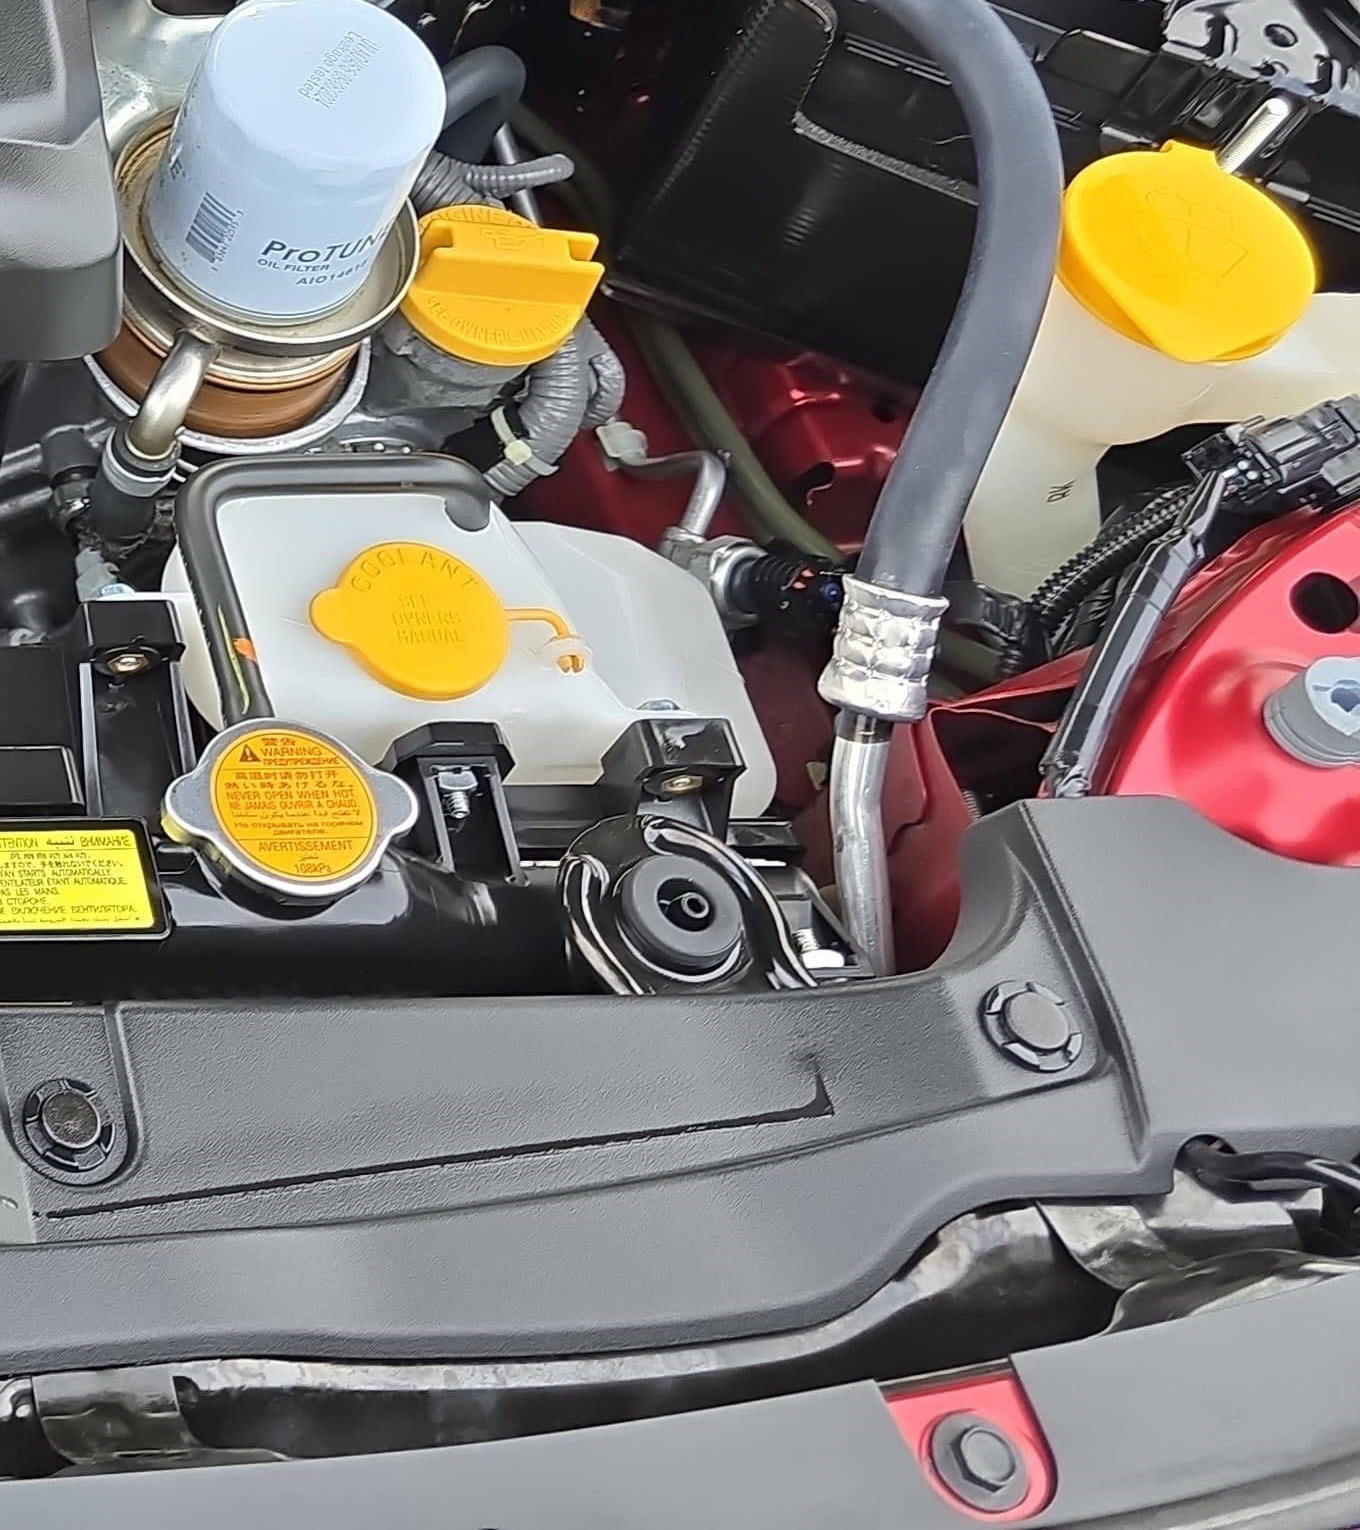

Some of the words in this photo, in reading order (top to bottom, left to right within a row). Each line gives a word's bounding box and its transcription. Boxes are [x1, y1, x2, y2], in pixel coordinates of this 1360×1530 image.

[256, 257, 281, 270] OIL
[283, 263, 331, 273] FILTER
[350, 548, 480, 593] COOLANT
[397, 627, 464, 645] MANUAL
[261, 746, 322, 757] WARNING
[226, 791, 260, 800] NEVER
[264, 790, 293, 799] OPEN
[296, 789, 329, 799] WHEN
[228, 801, 241, 810] NE
[244, 800, 277, 810] JAMAIS
[279, 799, 314, 810] OUVRIR
[79, 835, 132, 848] ВНИМАНИЕ
[258, 840, 353, 852] AVERTISSEMENT
[0, 870, 15, 878] FAN
[18, 869, 46, 878] STARTS
[293, 862, 333, 874] 108kPa
[15, 887, 30, 897] LES
[11, 906, 67, 916] ВКЛЮЧЕНИЕ
